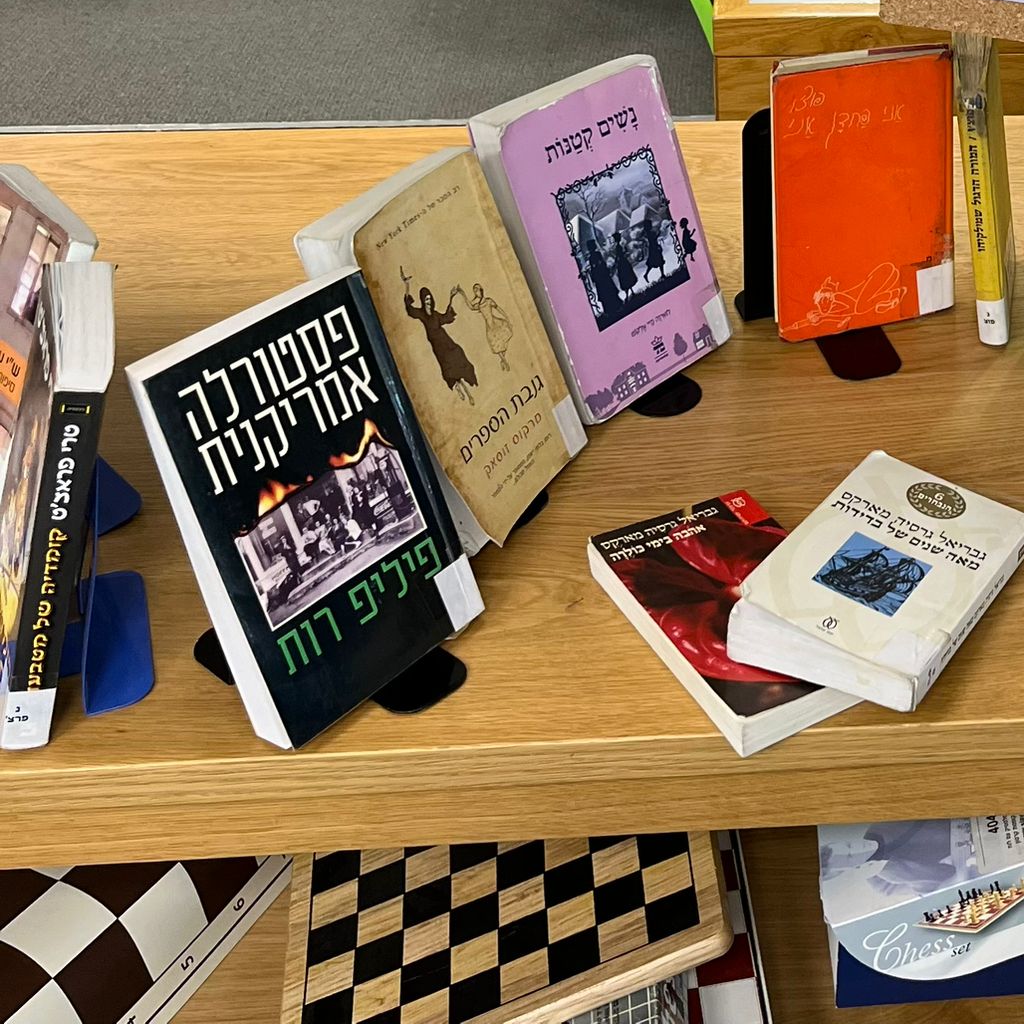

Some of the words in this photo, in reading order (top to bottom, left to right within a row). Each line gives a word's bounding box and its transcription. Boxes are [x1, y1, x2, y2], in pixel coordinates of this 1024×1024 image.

[178, 305, 360, 440] פסטורלה
[510, 375, 545, 414] גנבת
[62, 424, 80, 453] טרי
[198, 357, 379, 495] אמריקנית
[460, 407, 510, 464] הספרים
[512, 412, 542, 445] מרקוס
[50, 458, 76, 521] פראצ'ט
[917, 492, 952, 512] הנבחרים
[934, 492, 944, 501] 6
[677, 507, 719, 525] גבריאל
[831, 500, 883, 529] בדידות
[841, 491, 891, 519] מארקס
[600, 531, 644, 550] מארקס
[644, 521, 678, 537] גרסיה
[673, 524, 706, 540] אהבה
[887, 521, 908, 539] של
[892, 516, 934, 539] גרסיה
[646, 535, 673, 549] בימי
[909, 537, 944, 554] שנים
[939, 531, 987, 560] גבריאל
[40, 527, 68, 595] קומדיה
[945, 551, 980, 571] מאה
[350, 536, 441, 625] פיליפ
[33, 600, 51, 632] של
[276, 607, 343, 676] רות
[233, 897, 245, 912] 6
[863, 922, 955, 971] Chess
[951, 942, 971, 958] set
[181, 956, 194, 971] 5
